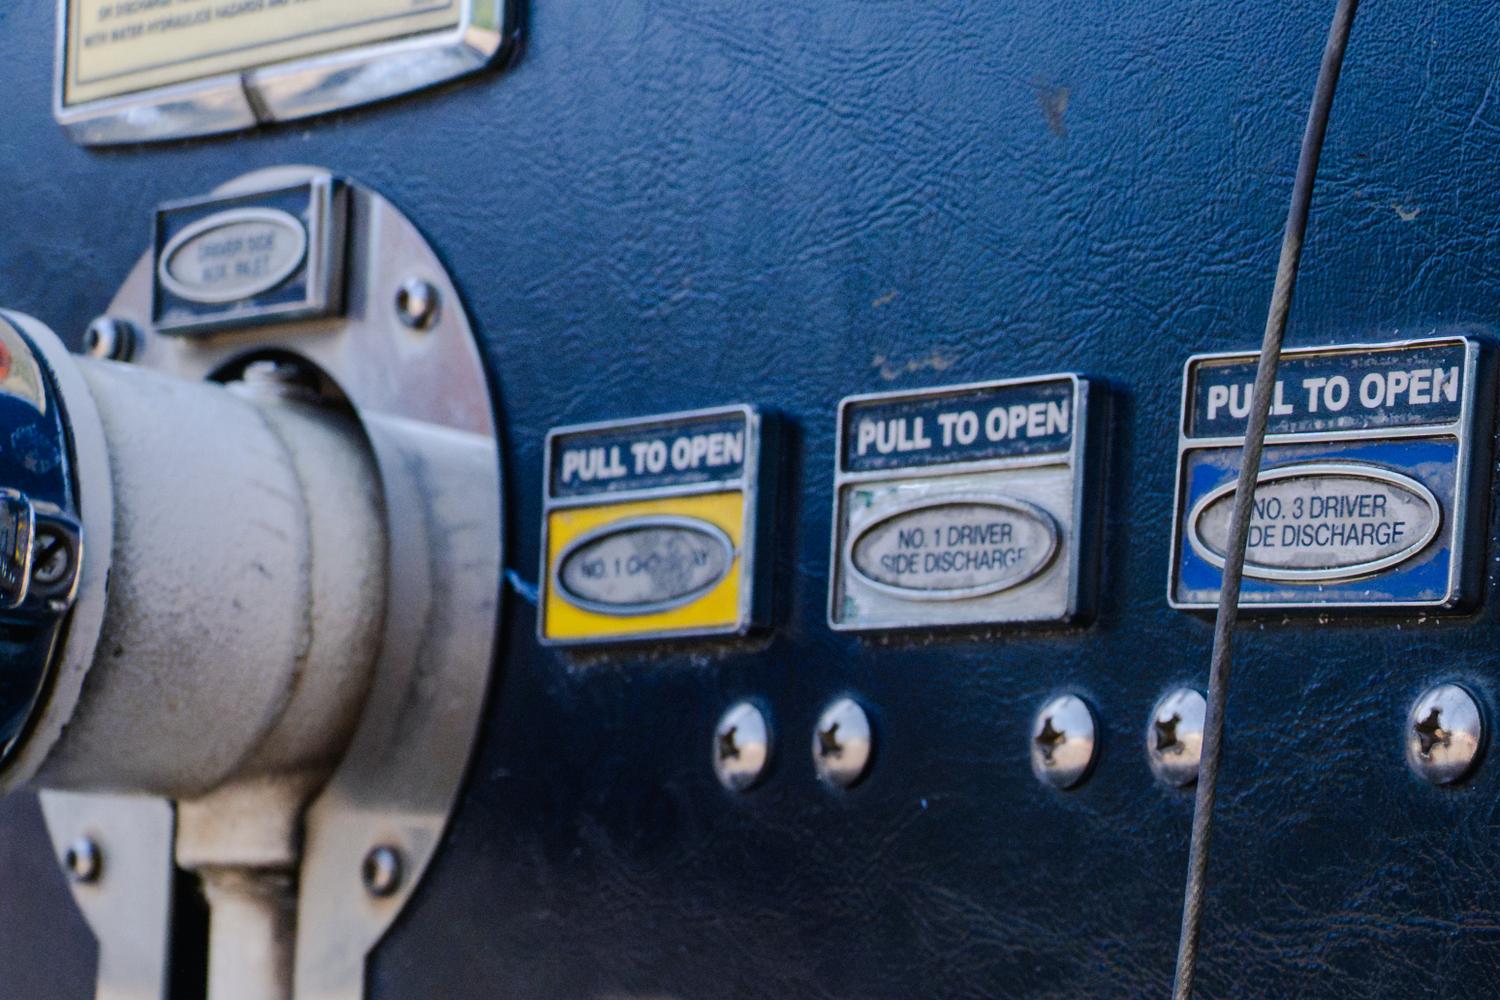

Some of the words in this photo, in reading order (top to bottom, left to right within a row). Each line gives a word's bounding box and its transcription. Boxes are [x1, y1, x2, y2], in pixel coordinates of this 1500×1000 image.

[1207, 380, 1294, 420] PUL
[1302, 374, 1350, 413] TO
[1358, 366, 1460, 408] OPEN
[857, 416, 932, 455] PULL
[937, 410, 979, 446] TO
[984, 399, 1070, 442] OPEN
[561, 446, 627, 483] PULL
[631, 440, 667, 474] TO
[671, 431, 745, 471] OPEN
[1252, 497, 1286, 520] NO.
[1292, 497, 1304, 520] 3
[1309, 494, 1388, 519] DRIVER
[934, 528, 941, 547] 1
[947, 523, 1012, 547] DRIVER
[881, 553, 921, 574] SIDE
